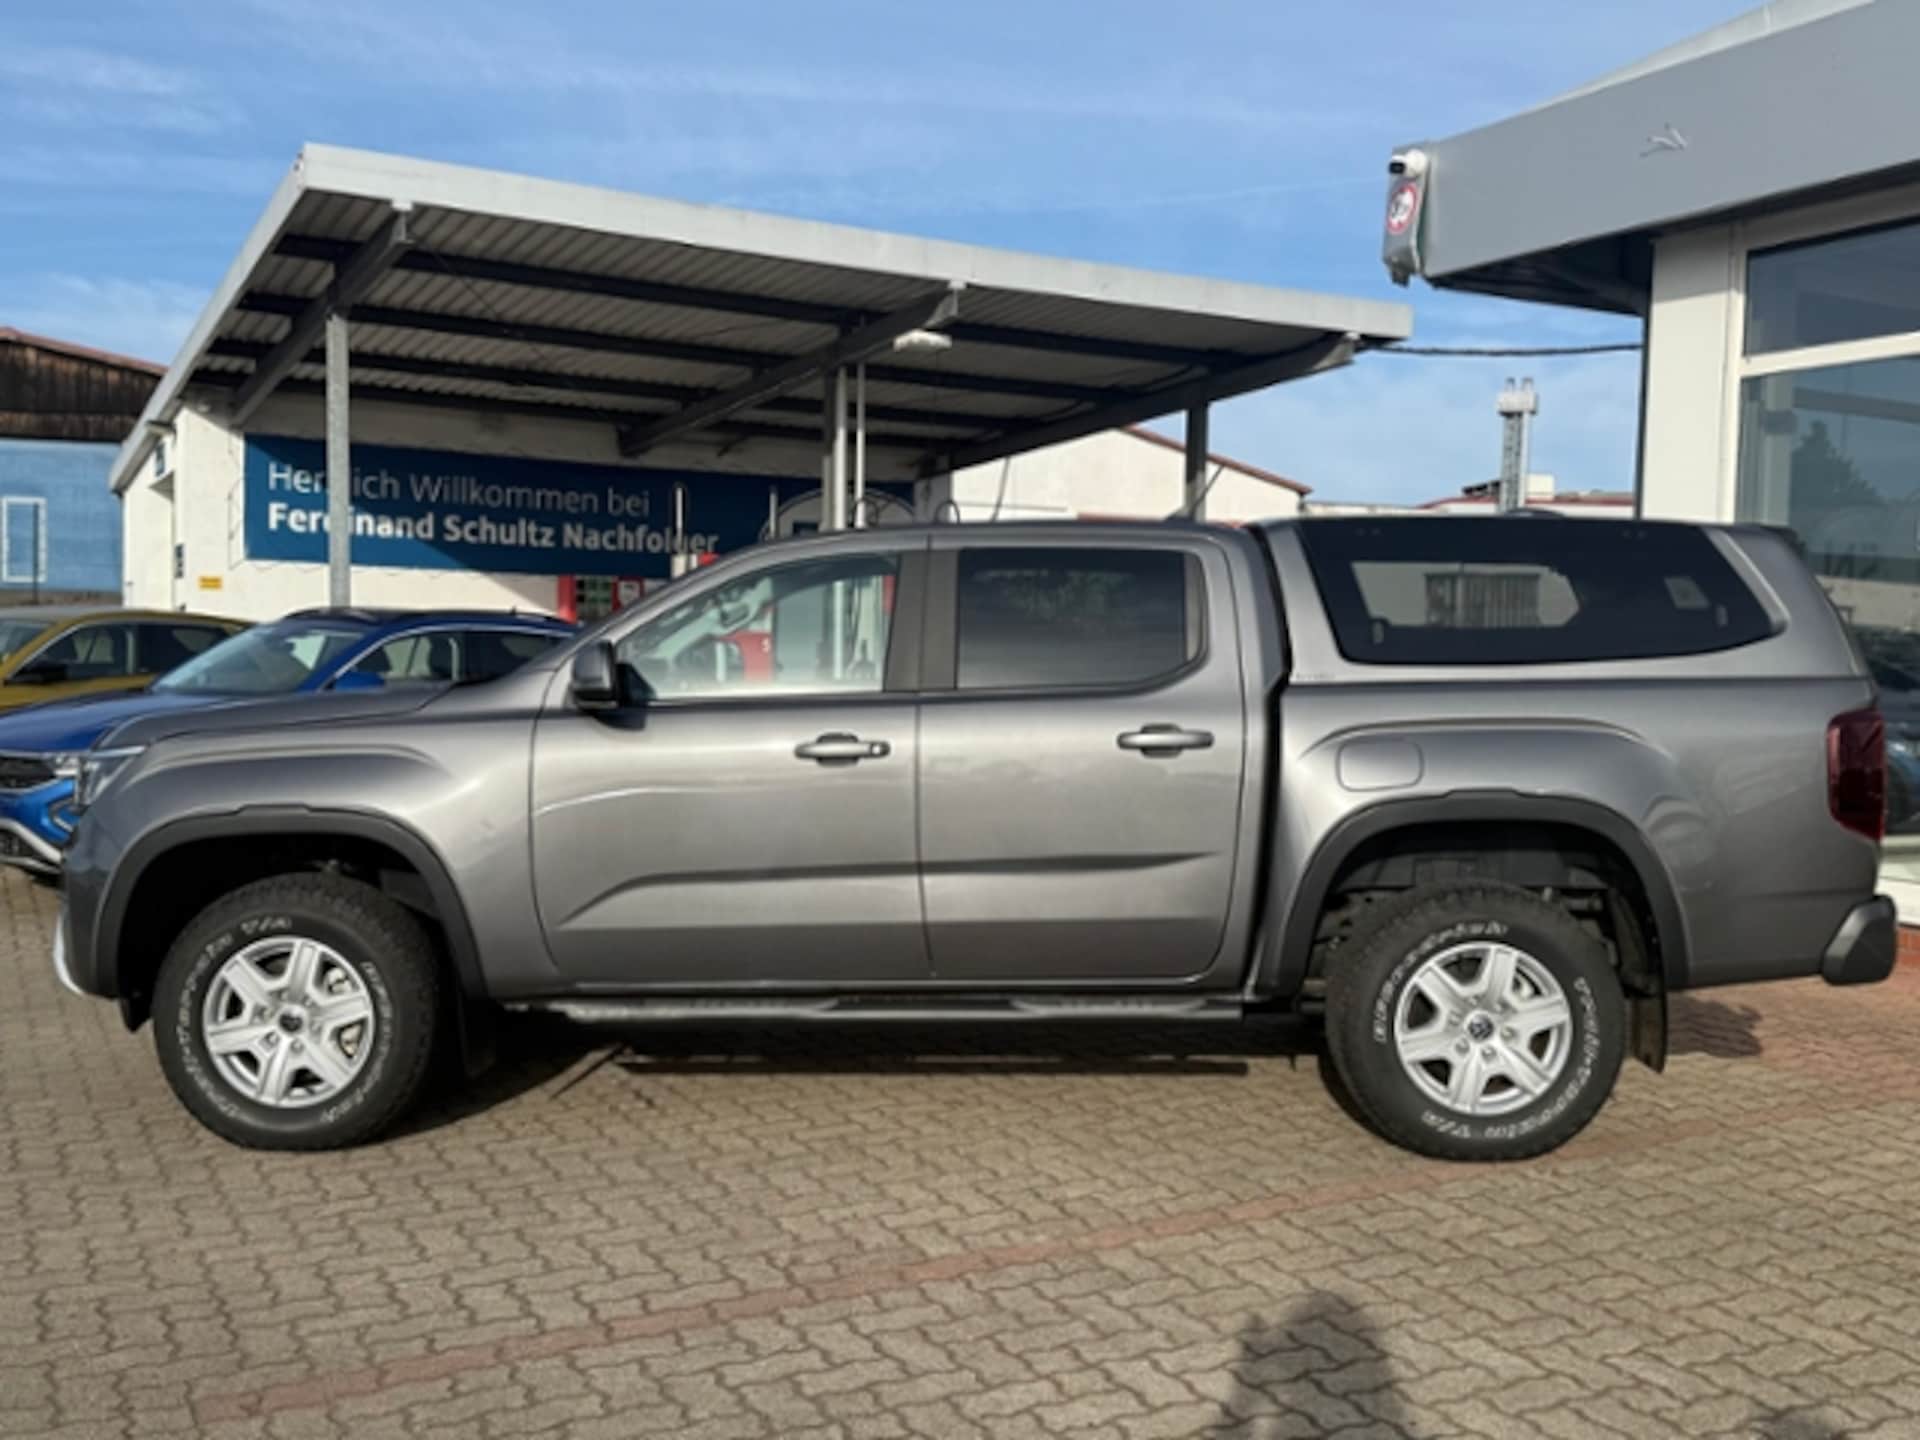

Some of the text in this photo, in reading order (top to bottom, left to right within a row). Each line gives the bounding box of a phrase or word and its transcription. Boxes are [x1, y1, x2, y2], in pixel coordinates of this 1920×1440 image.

[268, 462, 650, 516] Herich Willkommen bei
[443, 515, 556, 547] Schultz
